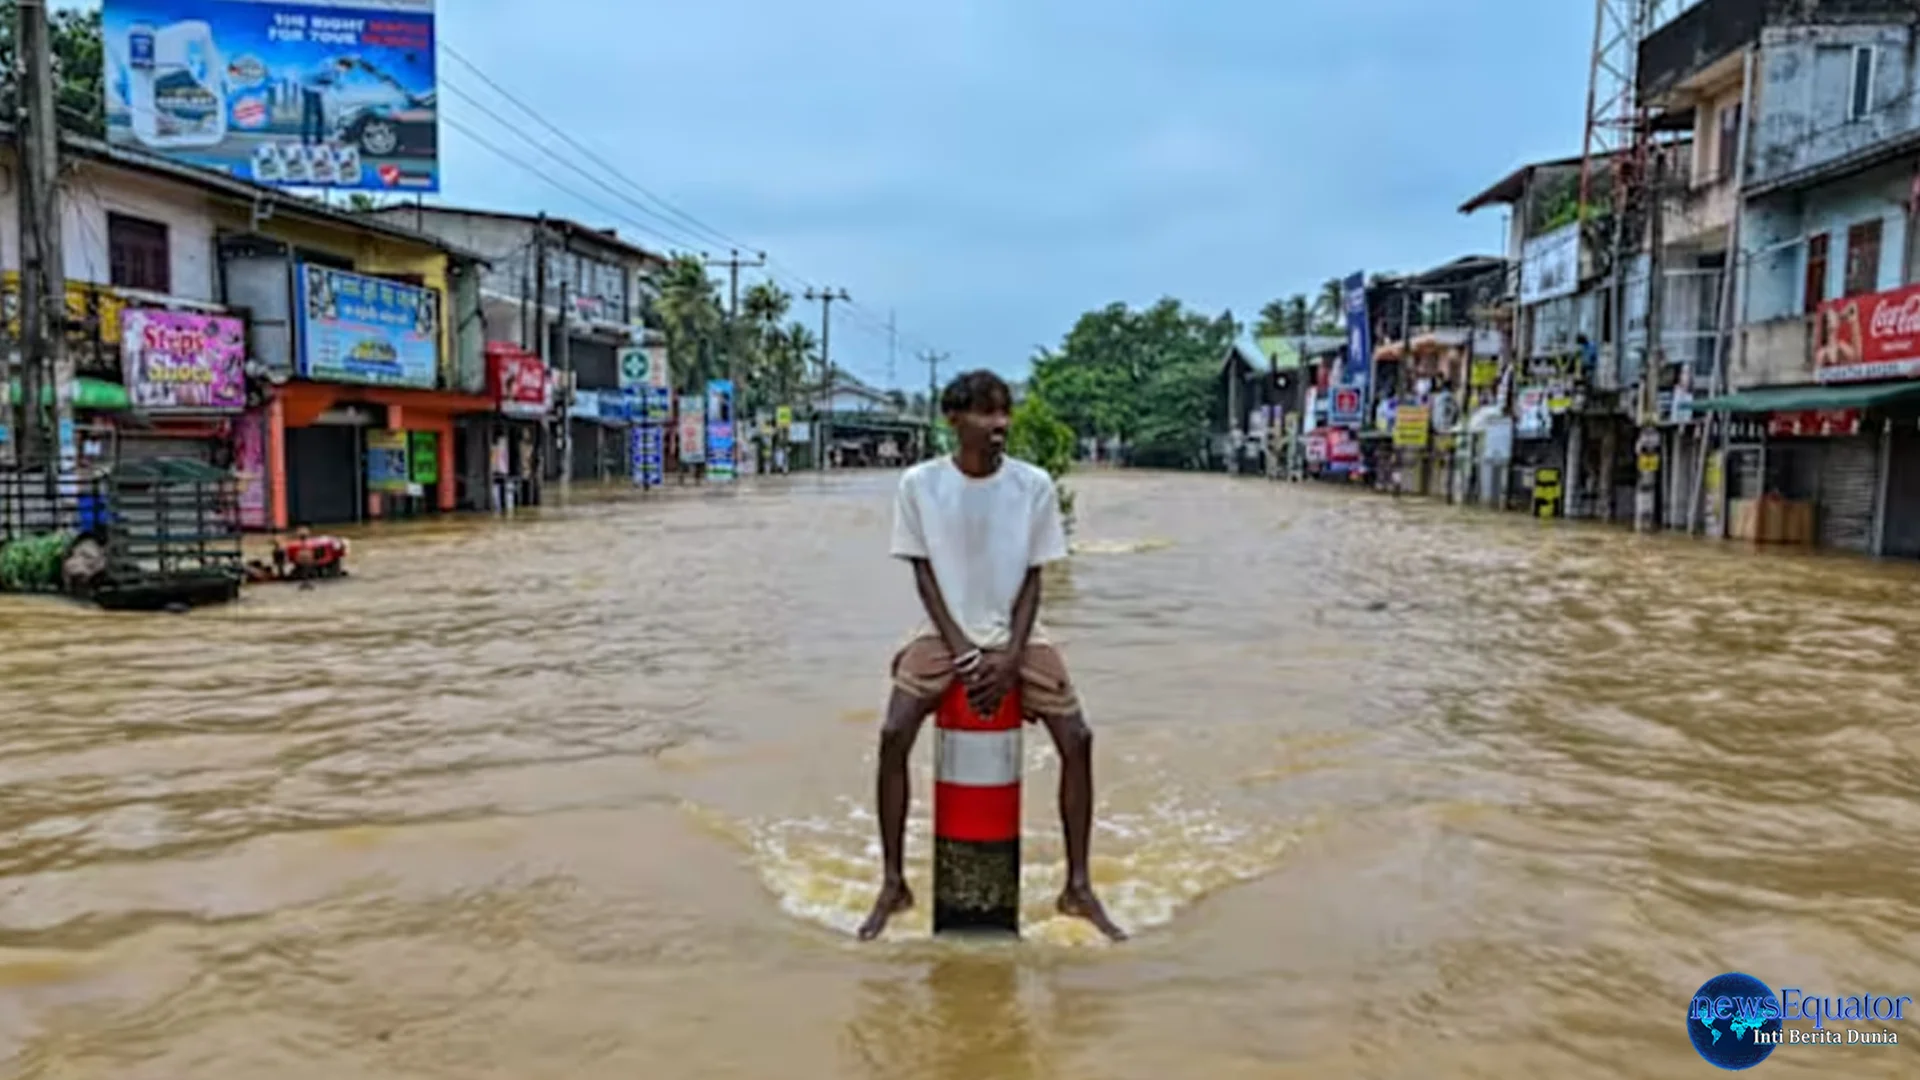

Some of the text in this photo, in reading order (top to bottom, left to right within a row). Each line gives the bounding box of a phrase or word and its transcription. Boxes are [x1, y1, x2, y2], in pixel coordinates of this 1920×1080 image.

[273, 13, 306, 27] THE
[311, 15, 365, 31] RIGHT
[268, 26, 304, 41] FOR
[309, 29, 357, 45] YOUR
[143, 324, 205, 356] Steps
